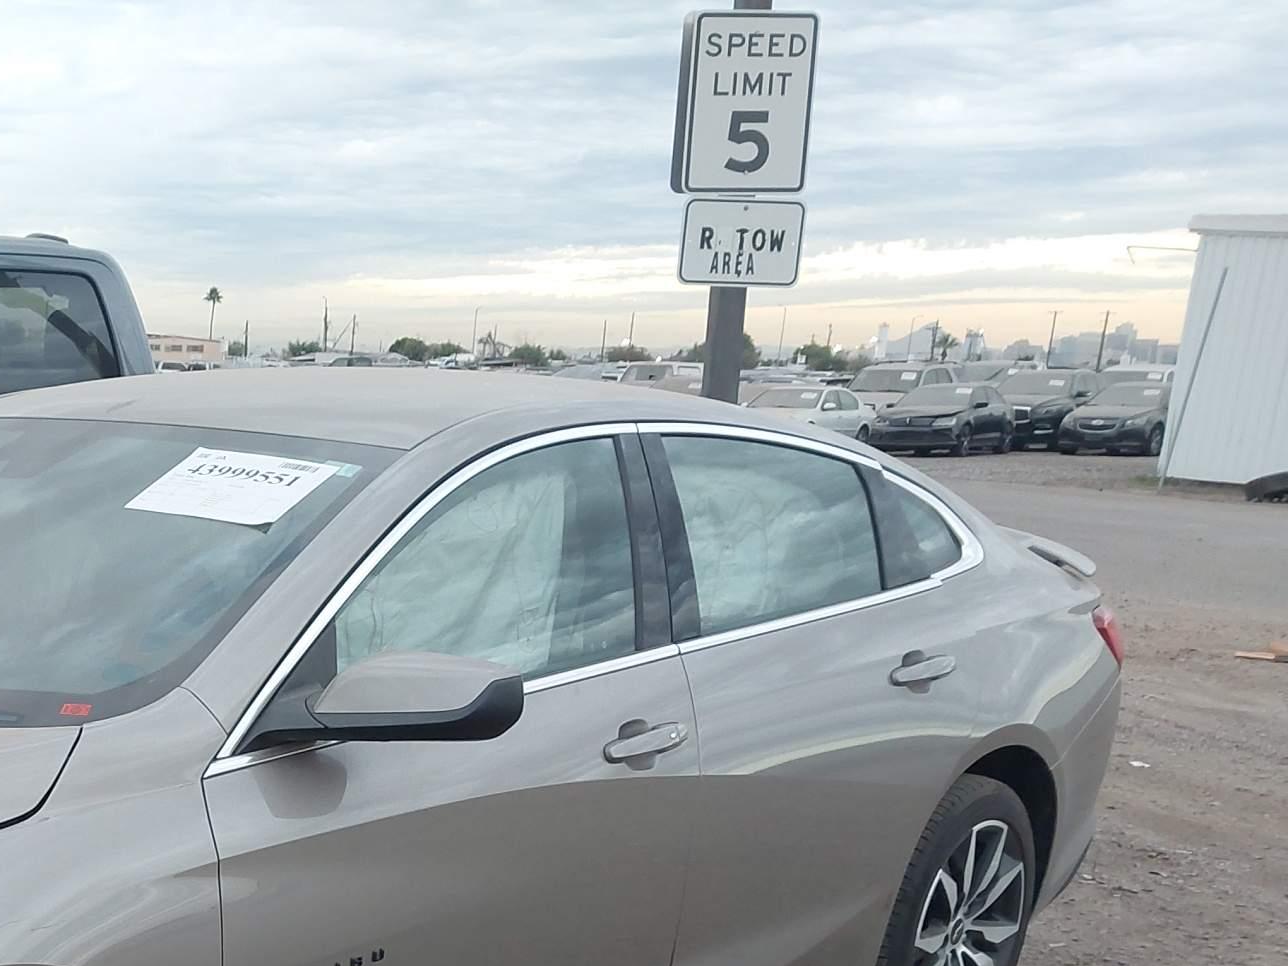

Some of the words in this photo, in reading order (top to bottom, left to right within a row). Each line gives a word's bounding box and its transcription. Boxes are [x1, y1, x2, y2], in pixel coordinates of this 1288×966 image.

[705, 32, 807, 58] SPEED
[713, 72, 793, 96] LIMIT
[724, 110, 770, 174] 5
[736, 228, 785, 253] TOW
[710, 251, 754, 275] AREA
[187, 463, 301, 487] 43999551
